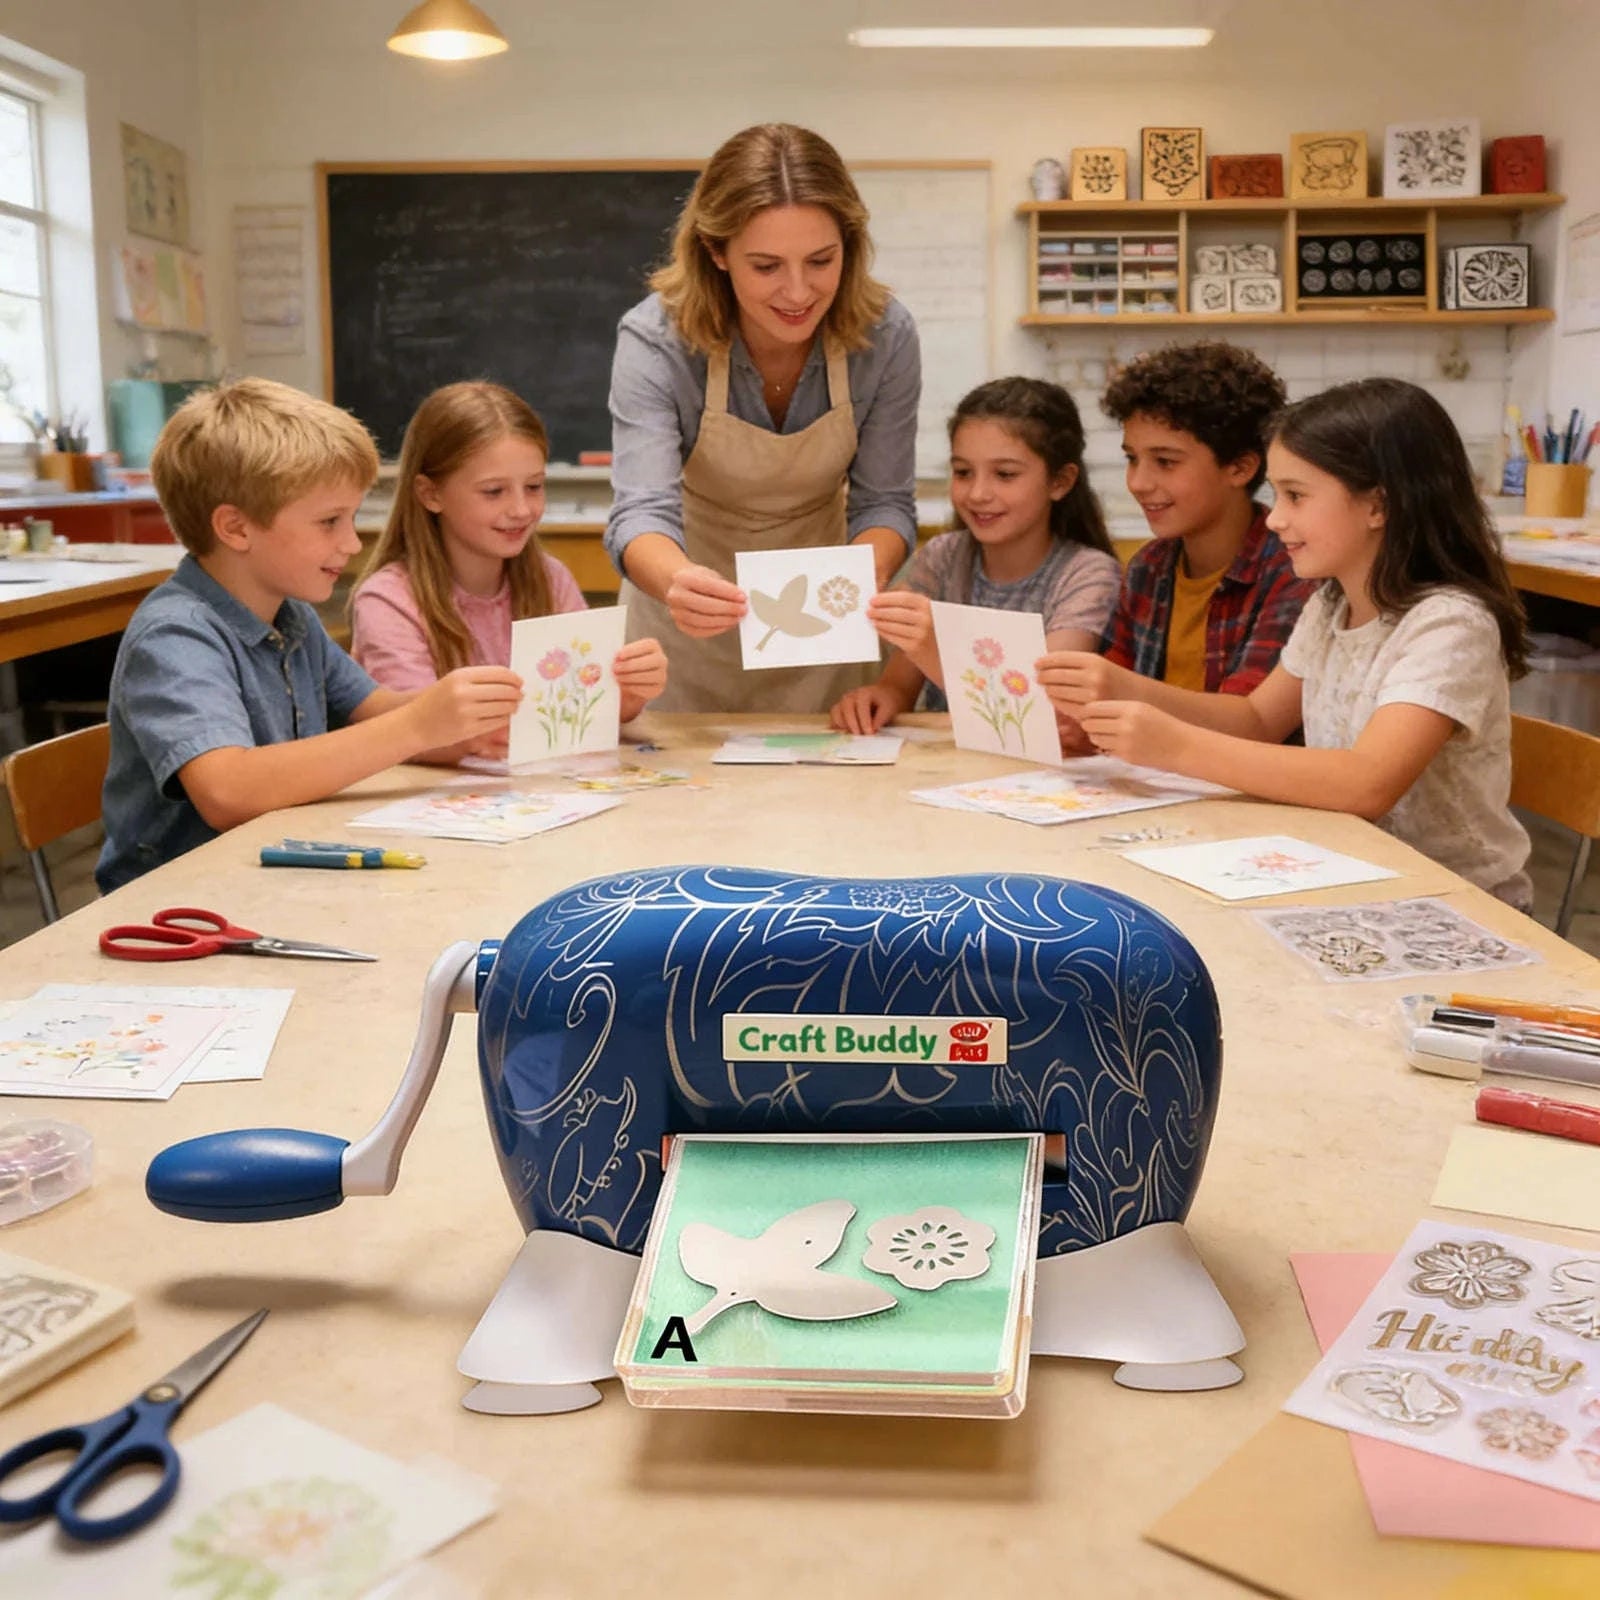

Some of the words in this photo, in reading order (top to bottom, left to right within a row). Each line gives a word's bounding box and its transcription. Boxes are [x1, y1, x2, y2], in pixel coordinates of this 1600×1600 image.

[738, 1025, 825, 1053] Craft
[835, 1026, 937, 1060] Buddy
[650, 1316, 698, 1362] A
